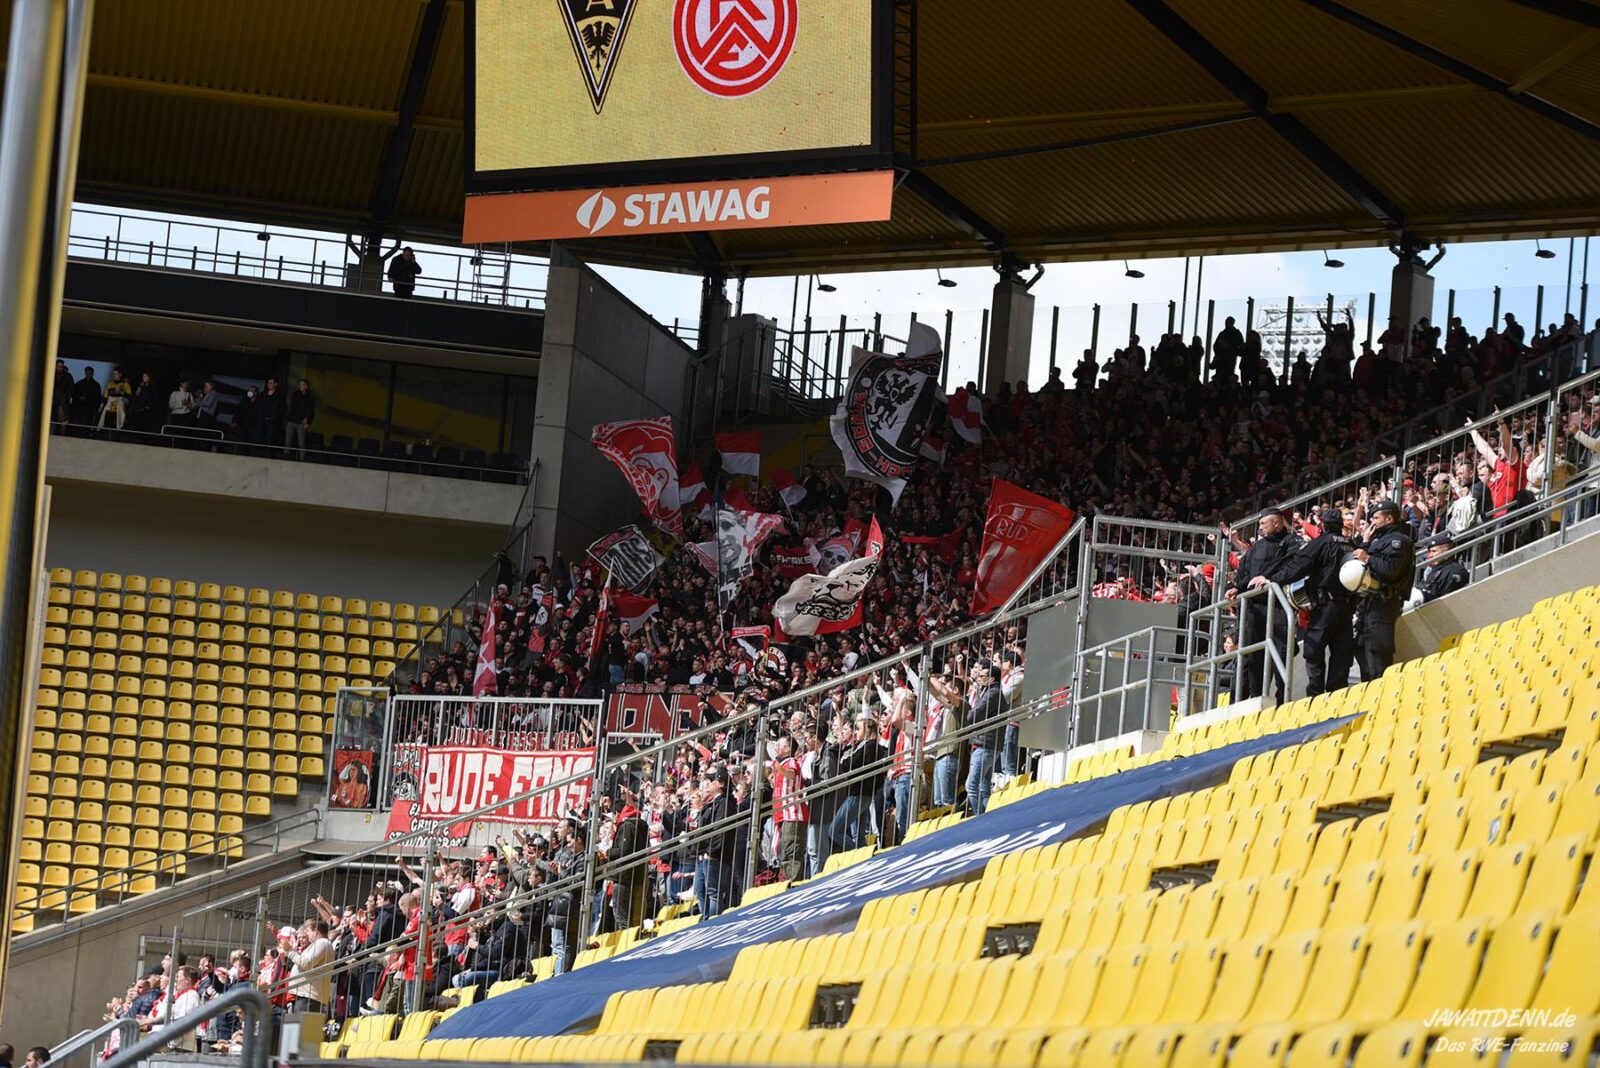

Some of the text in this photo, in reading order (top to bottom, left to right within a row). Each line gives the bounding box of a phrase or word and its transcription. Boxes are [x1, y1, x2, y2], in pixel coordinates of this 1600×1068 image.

[623, 186, 771, 227] STAWAG
[423, 753, 593, 819] RUDE FANS
